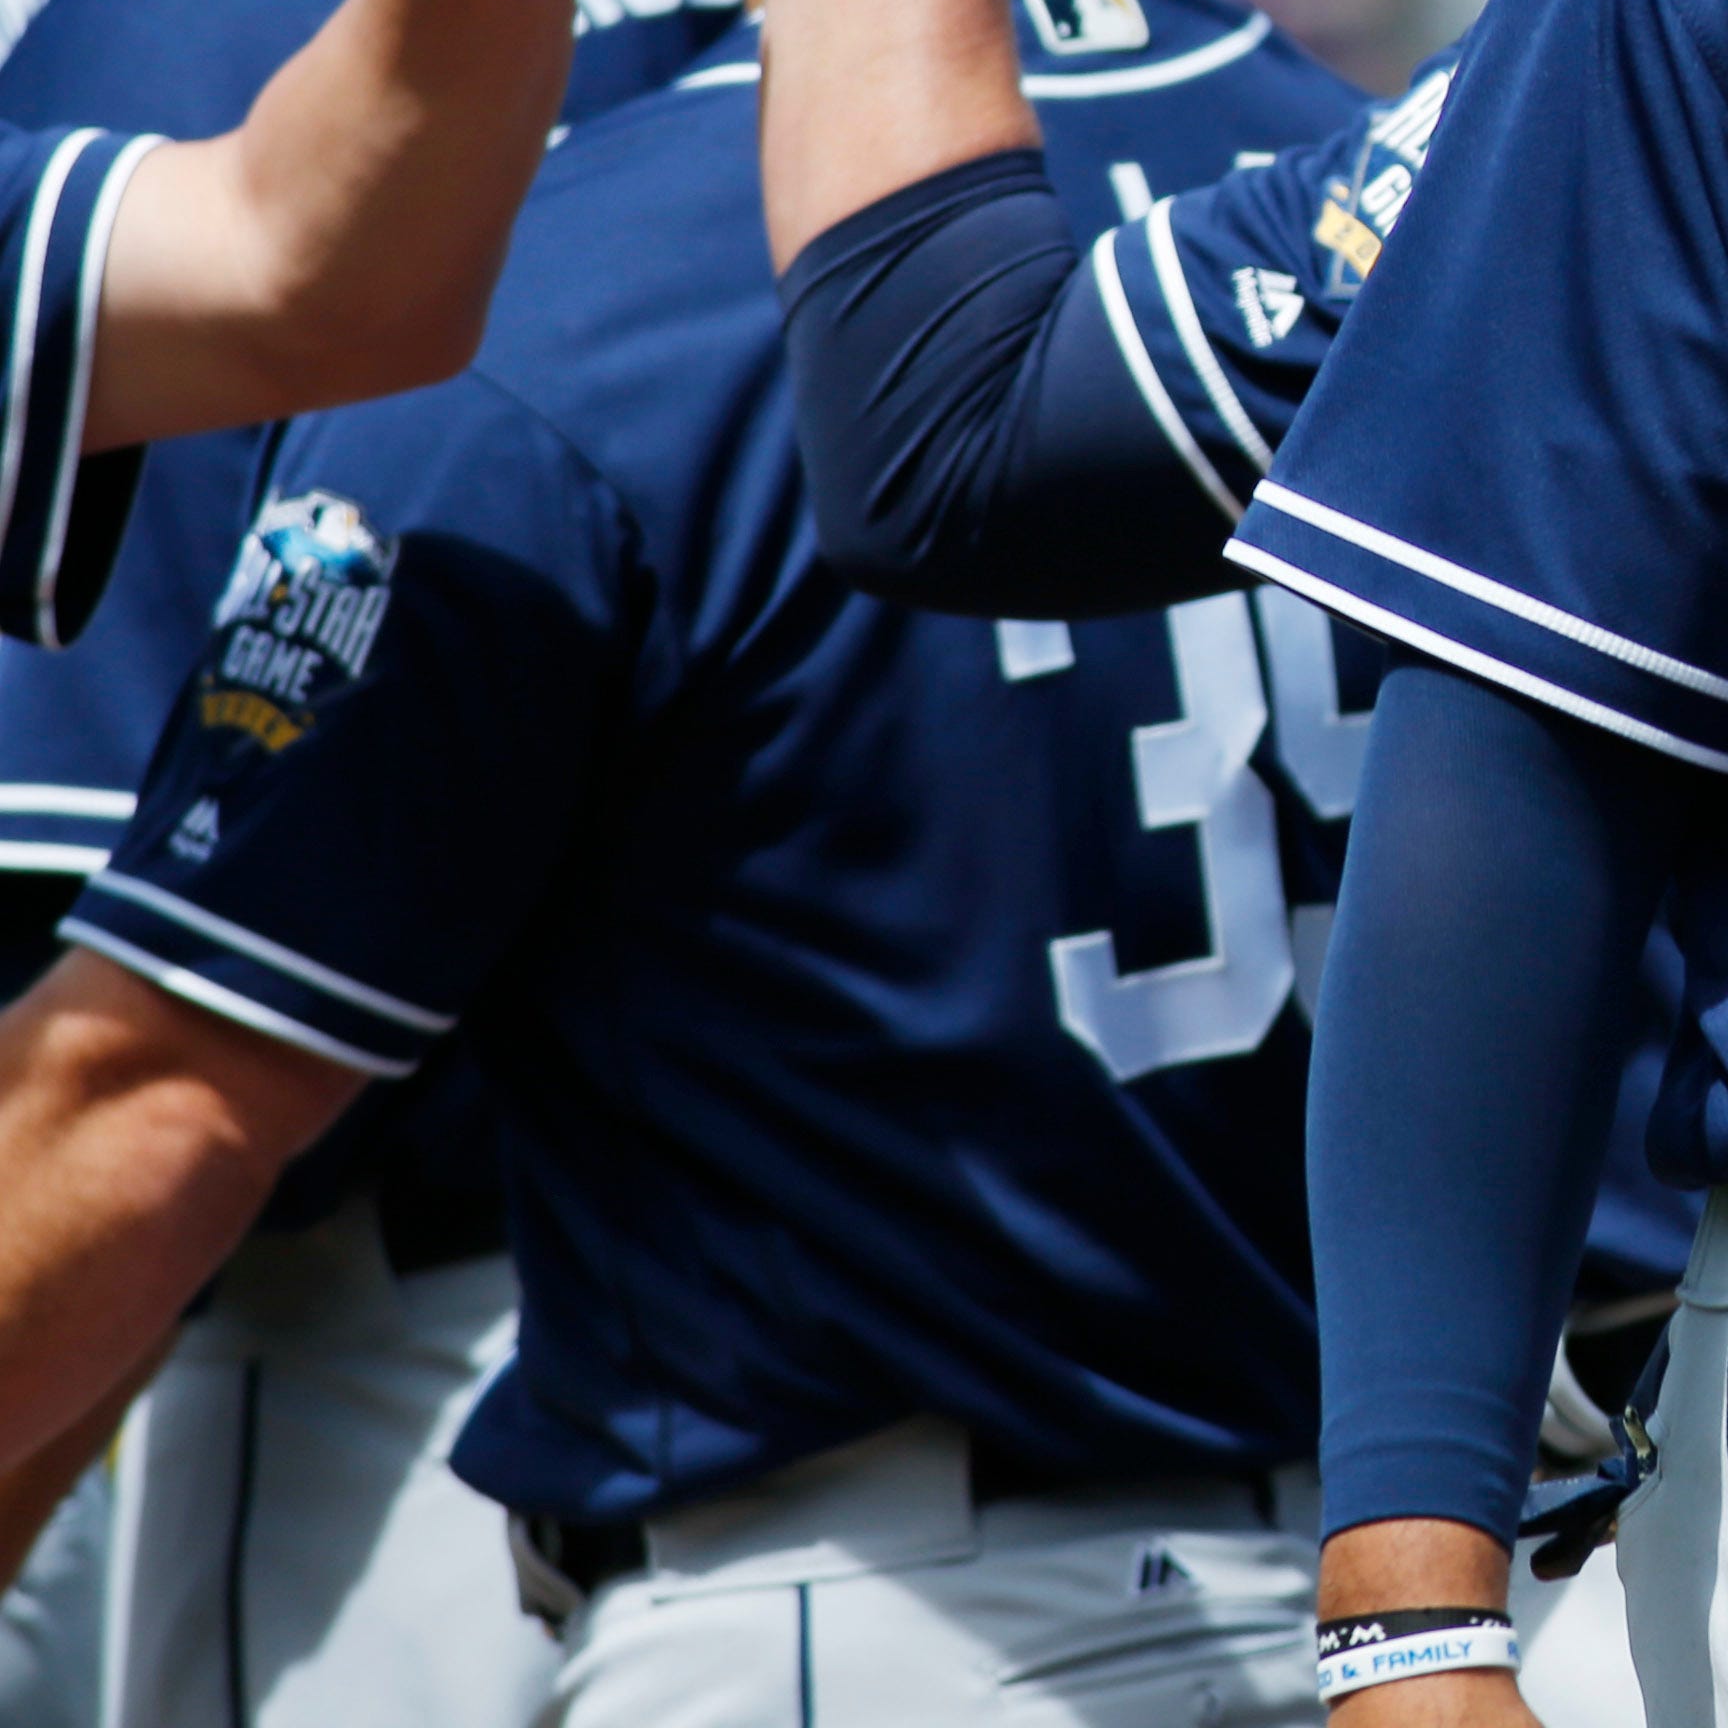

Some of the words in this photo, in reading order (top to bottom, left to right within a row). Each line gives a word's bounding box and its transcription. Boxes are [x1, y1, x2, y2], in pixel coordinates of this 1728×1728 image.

[220, 624, 325, 705] GAME
[1341, 1663, 1360, 1679] &
[1373, 1641, 1473, 1673] FAMILY
